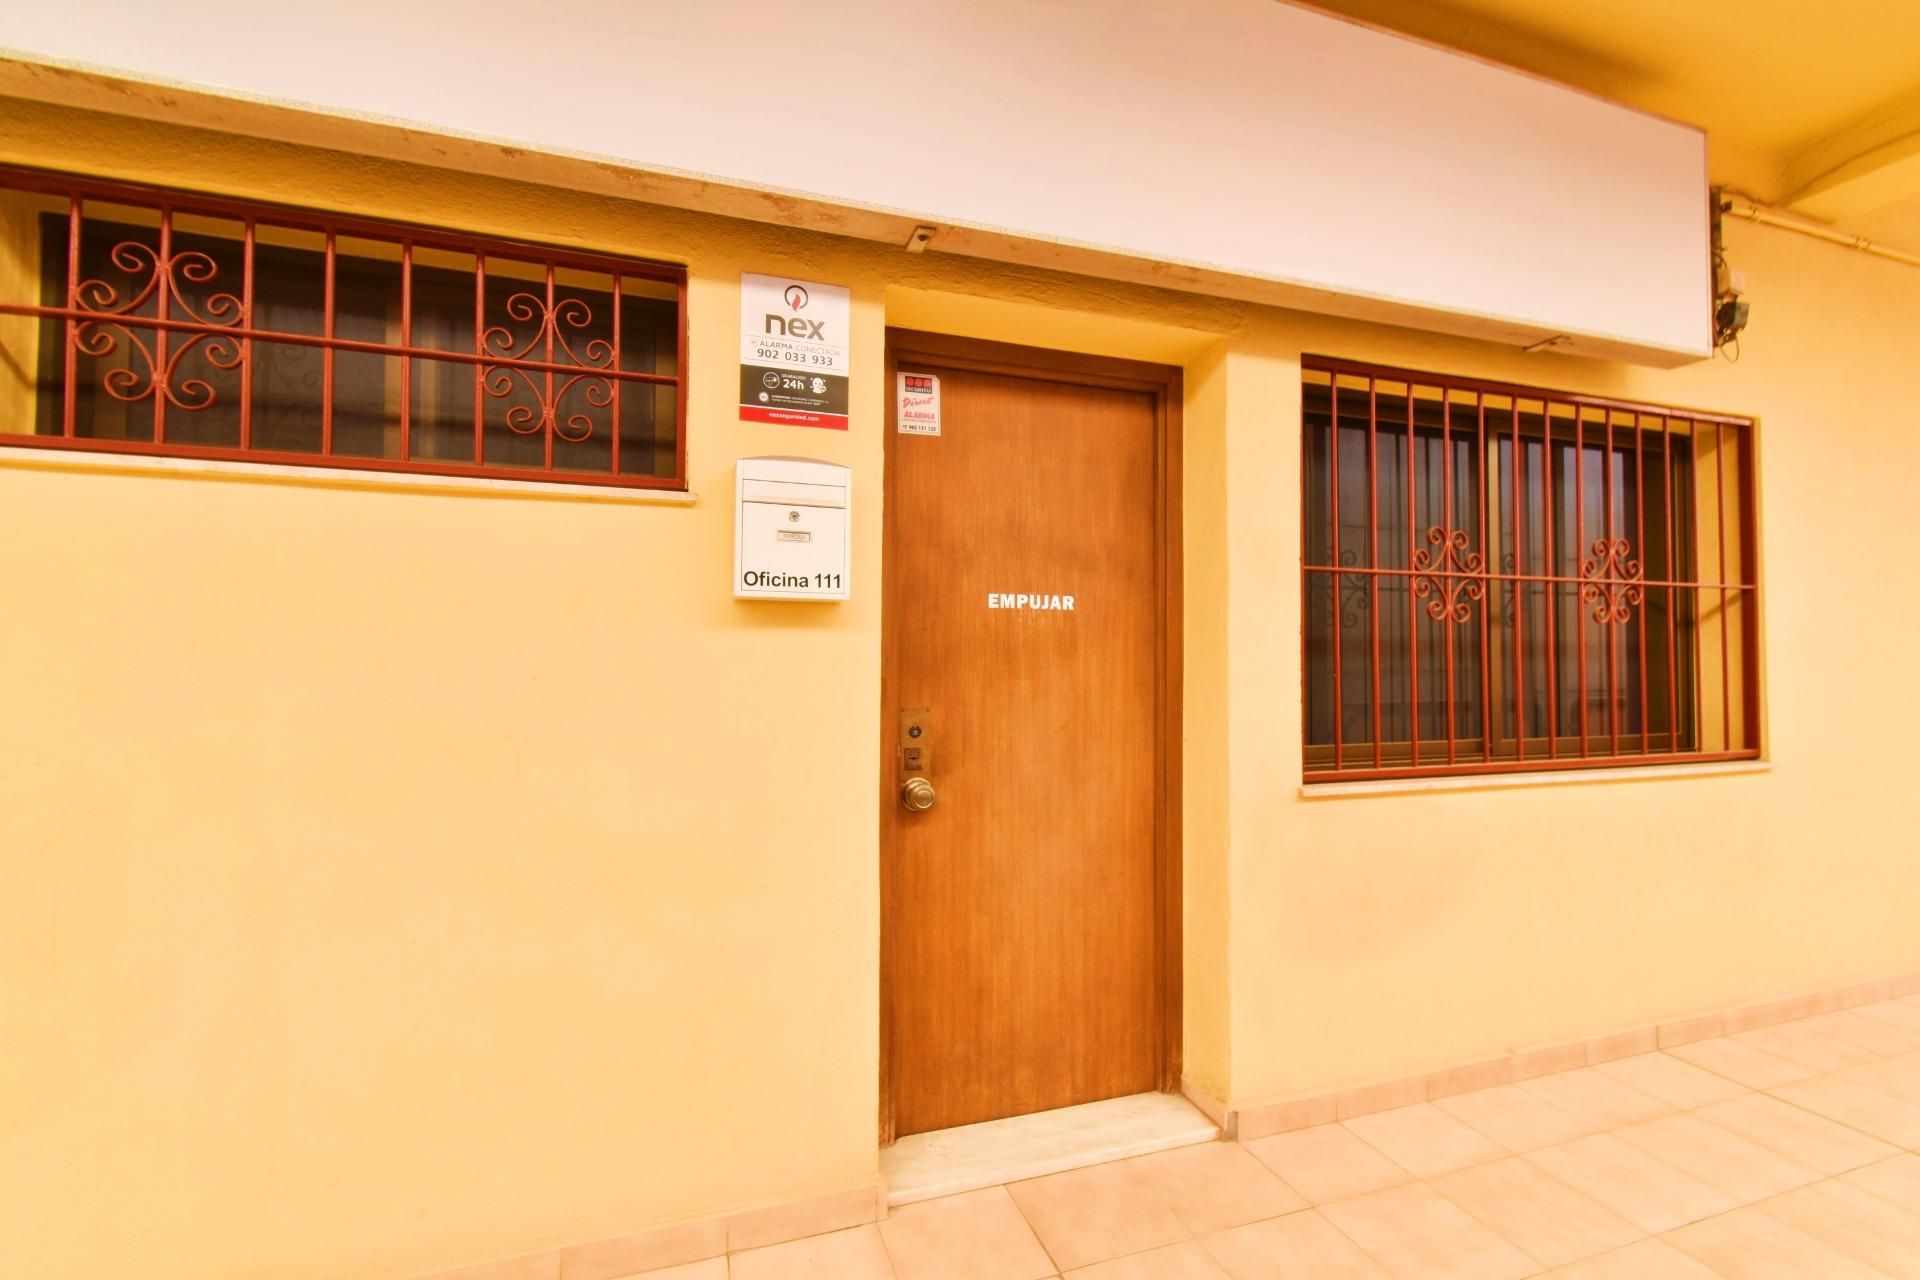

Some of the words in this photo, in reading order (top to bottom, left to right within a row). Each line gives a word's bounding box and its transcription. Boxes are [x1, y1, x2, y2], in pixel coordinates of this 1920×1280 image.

[765, 313, 825, 341] nex
[760, 340, 793, 350] ALARMA
[757, 348, 779, 359] 902
[785, 351, 806, 363] 033
[812, 355, 833, 366] 933
[783, 378, 805, 390] 24h
[904, 411, 935, 420] ALARMA
[743, 571, 809, 588] Oficina
[814, 573, 841, 589] 111
[988, 593, 1075, 610] EMPUJAR
